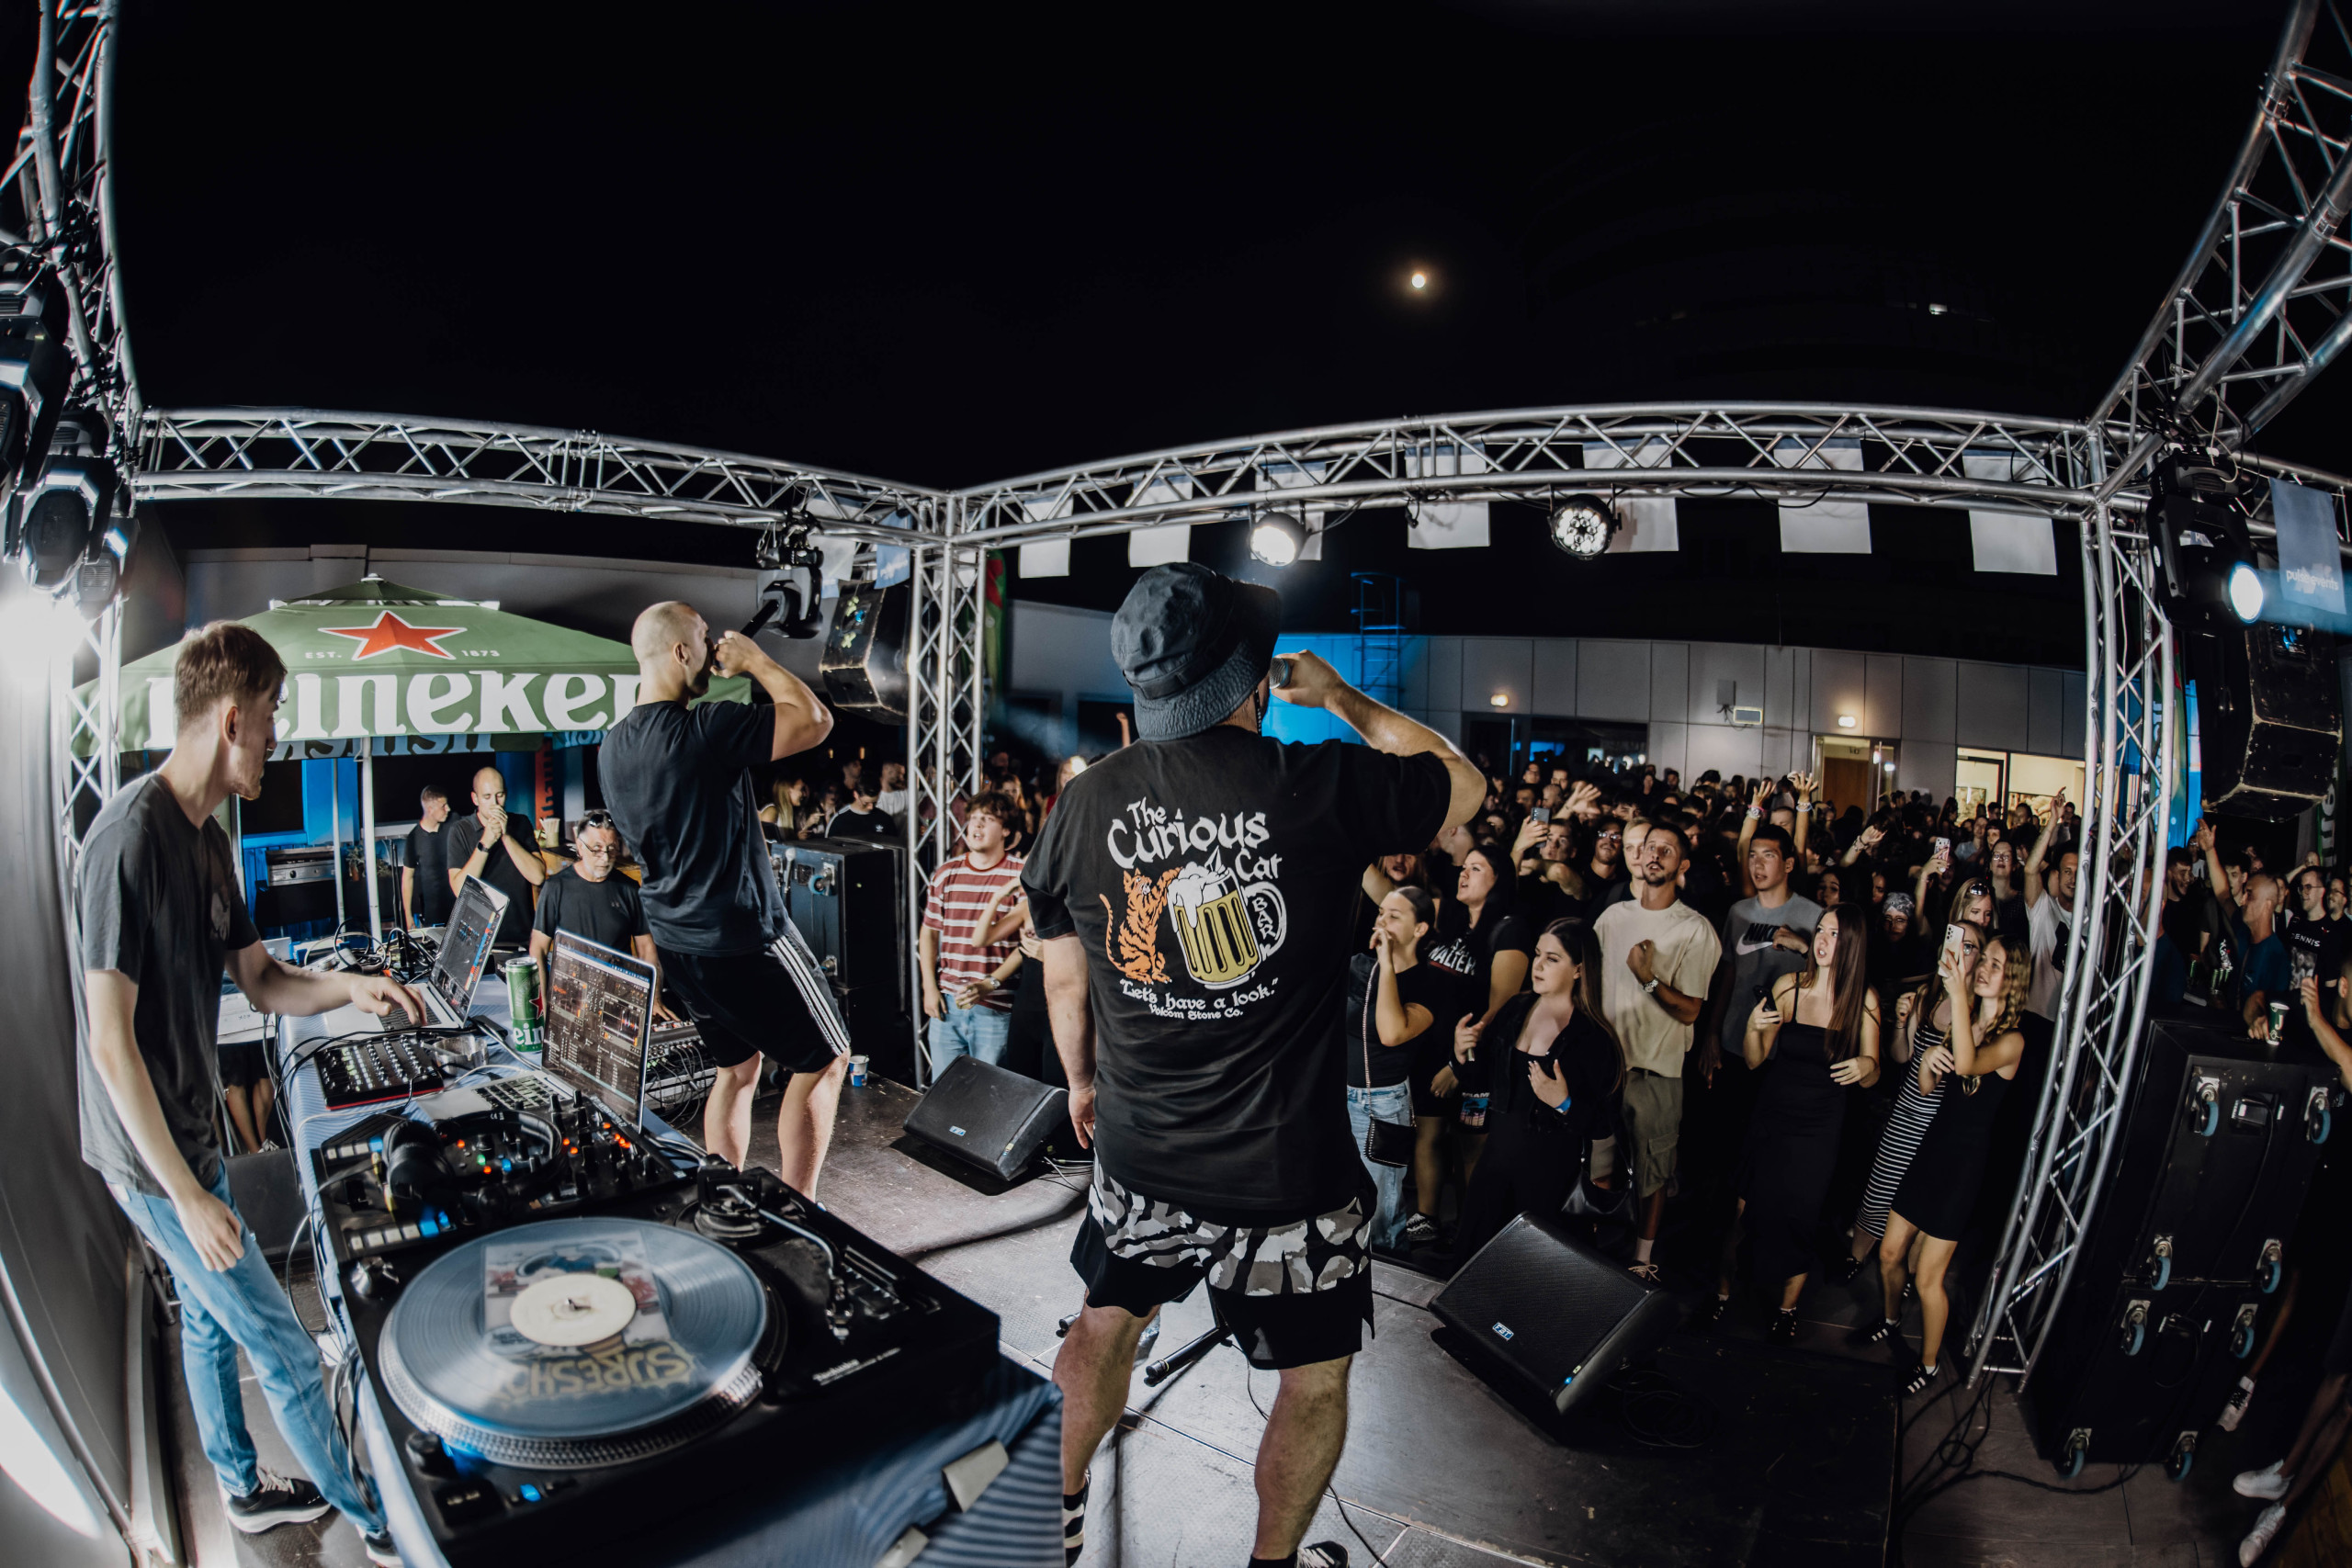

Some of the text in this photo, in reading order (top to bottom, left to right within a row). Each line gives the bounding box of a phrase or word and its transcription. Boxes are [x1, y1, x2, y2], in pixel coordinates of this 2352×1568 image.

[305, 649, 500, 660] EST. 1873
[143, 671, 640, 749] ineke
[1126, 796, 1167, 829] The
[1107, 807, 1270, 869] Curious
[1251, 897, 1277, 940] BAR
[1148, 1003, 1244, 1021] Volcom Stone Co.
[1165, 992, 1206, 1010] have
[1213, 998, 1227, 1009] a
[1493, 1323, 1513, 1340] FBT
